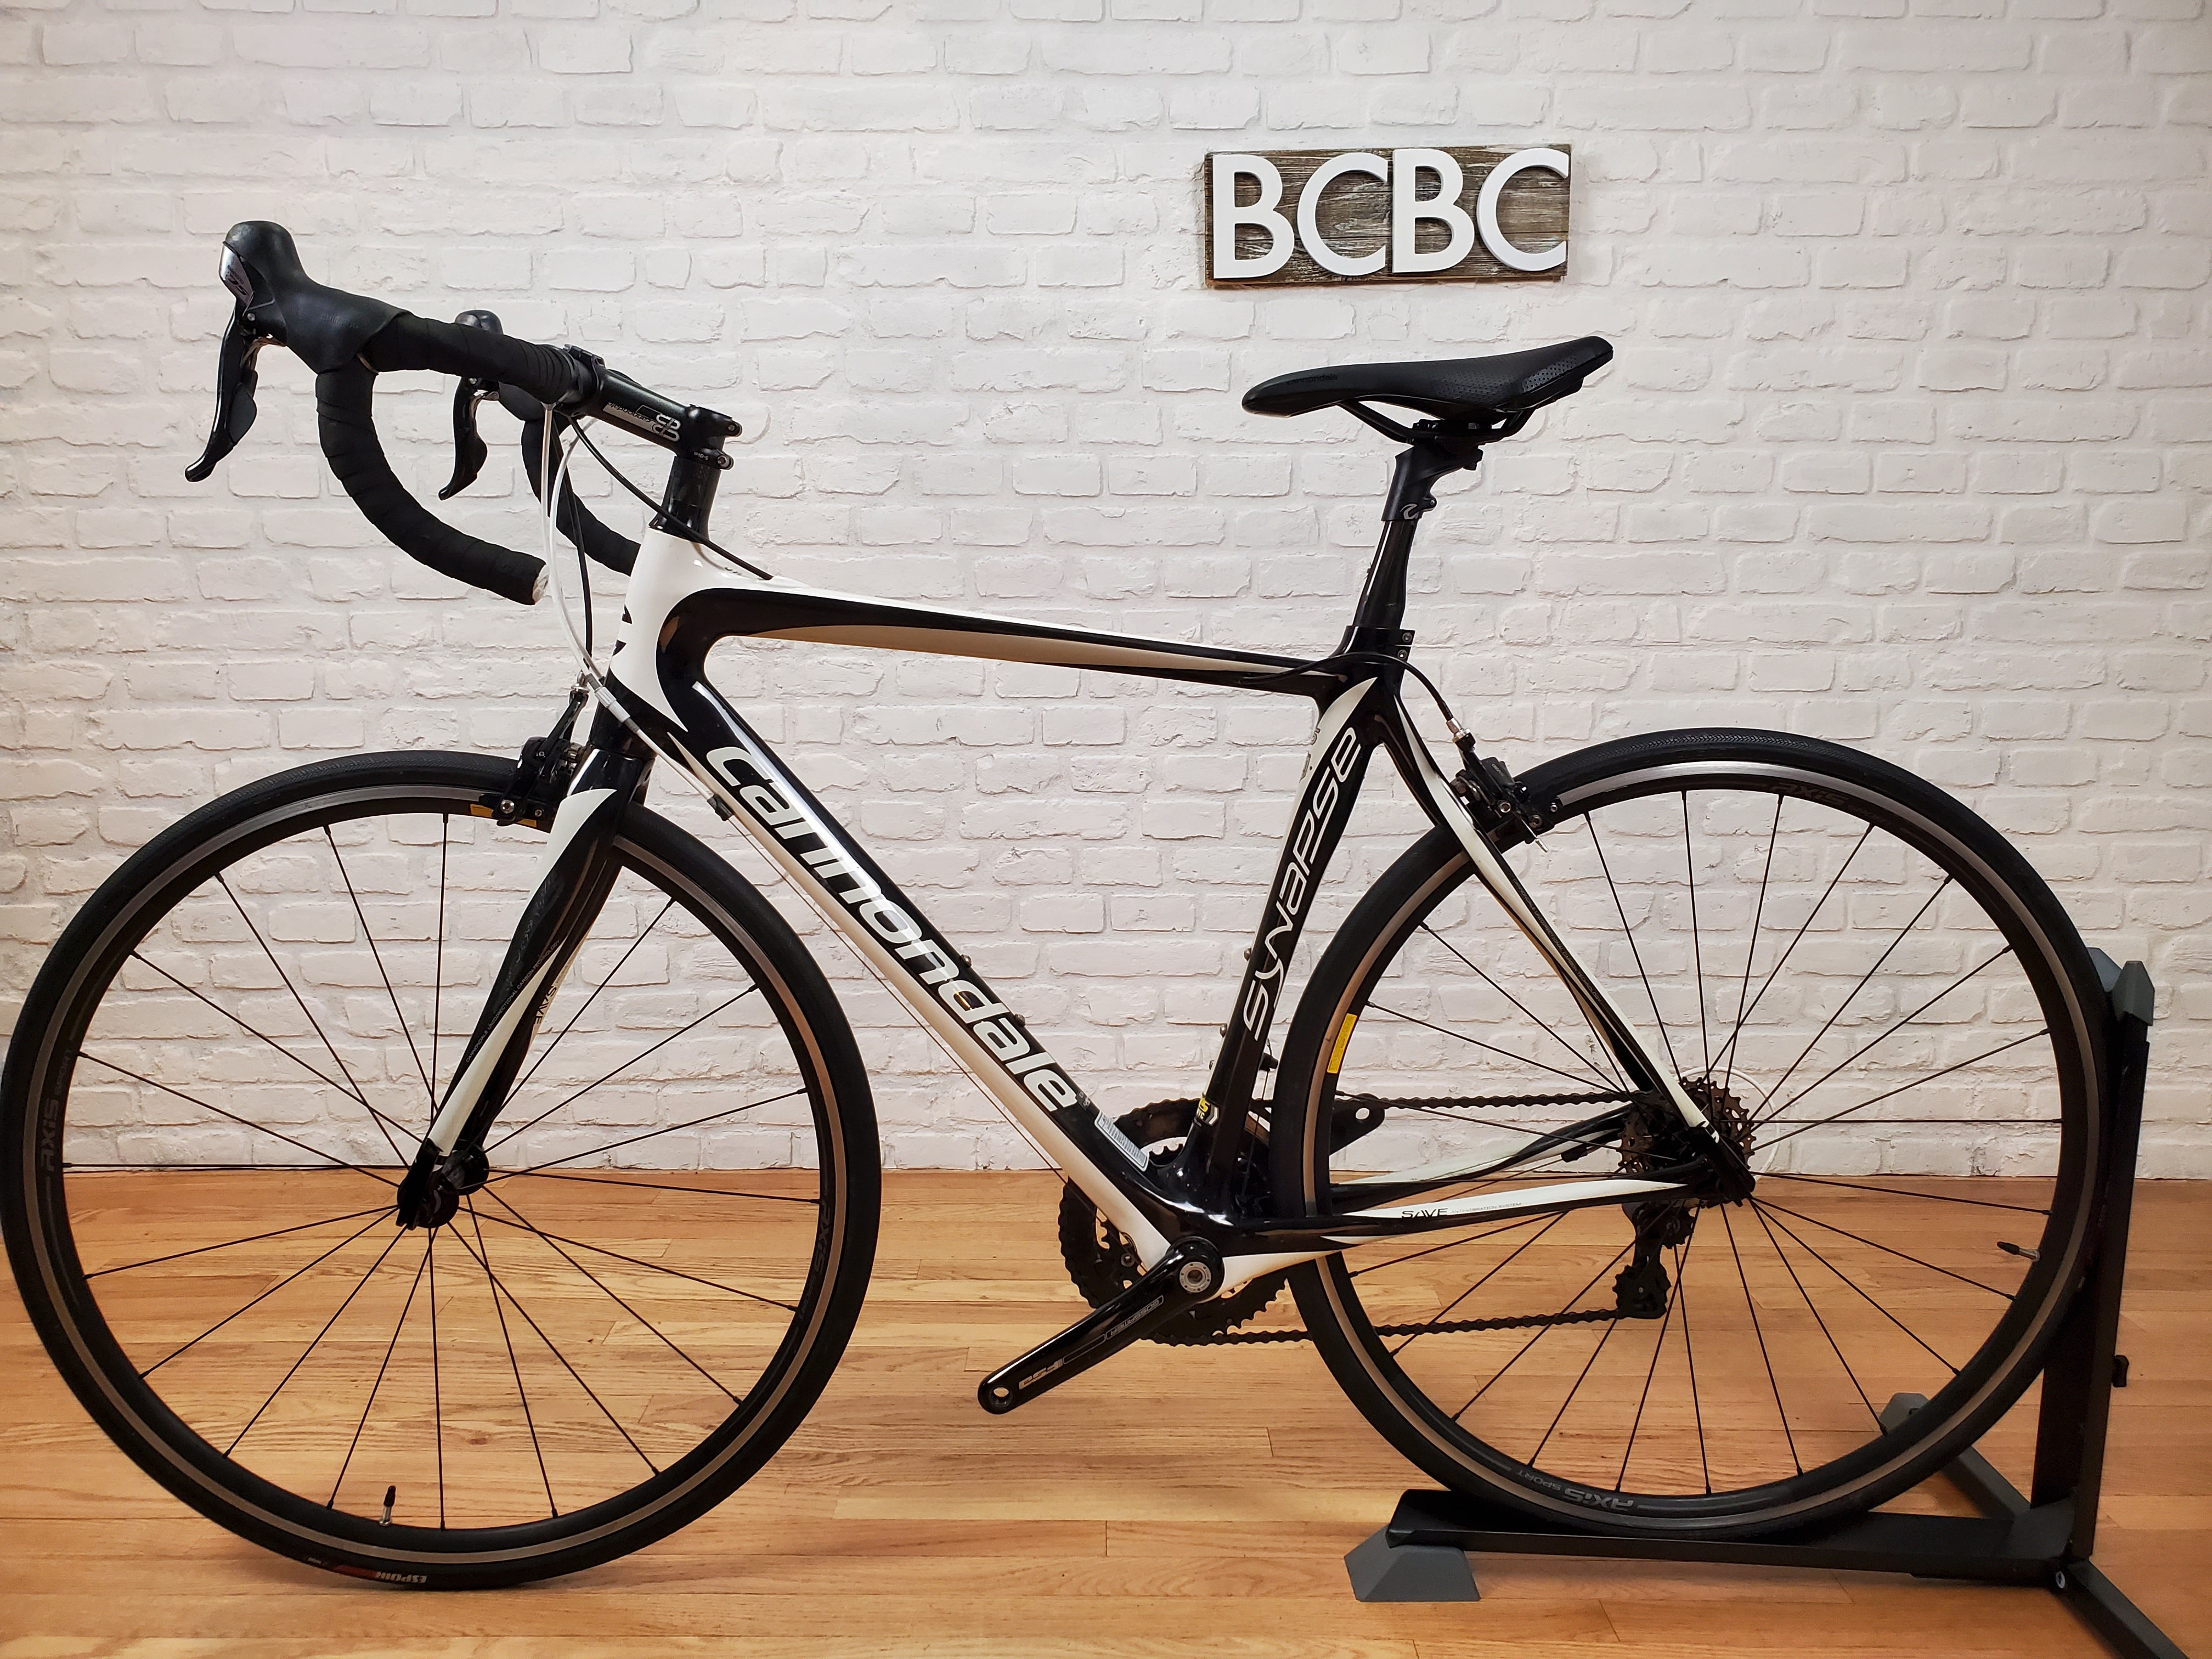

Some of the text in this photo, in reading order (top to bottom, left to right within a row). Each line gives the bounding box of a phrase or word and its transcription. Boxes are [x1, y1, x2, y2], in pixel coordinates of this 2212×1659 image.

[1212, 148, 1568, 279] BCBC
[706, 746, 1077, 1112] cannondale
[466, 1030, 488, 1063] CANNONDALE
[488, 989, 518, 1031] UNIDIRECTIONAL
[517, 968, 534, 989] CARBON
[534, 986, 557, 1025] SAVE
[1402, 1208, 1448, 1218] SAVE
[1111, 1299, 1160, 1335] GOSSAMER
[1515, 1470, 1561, 1491] SPORT
